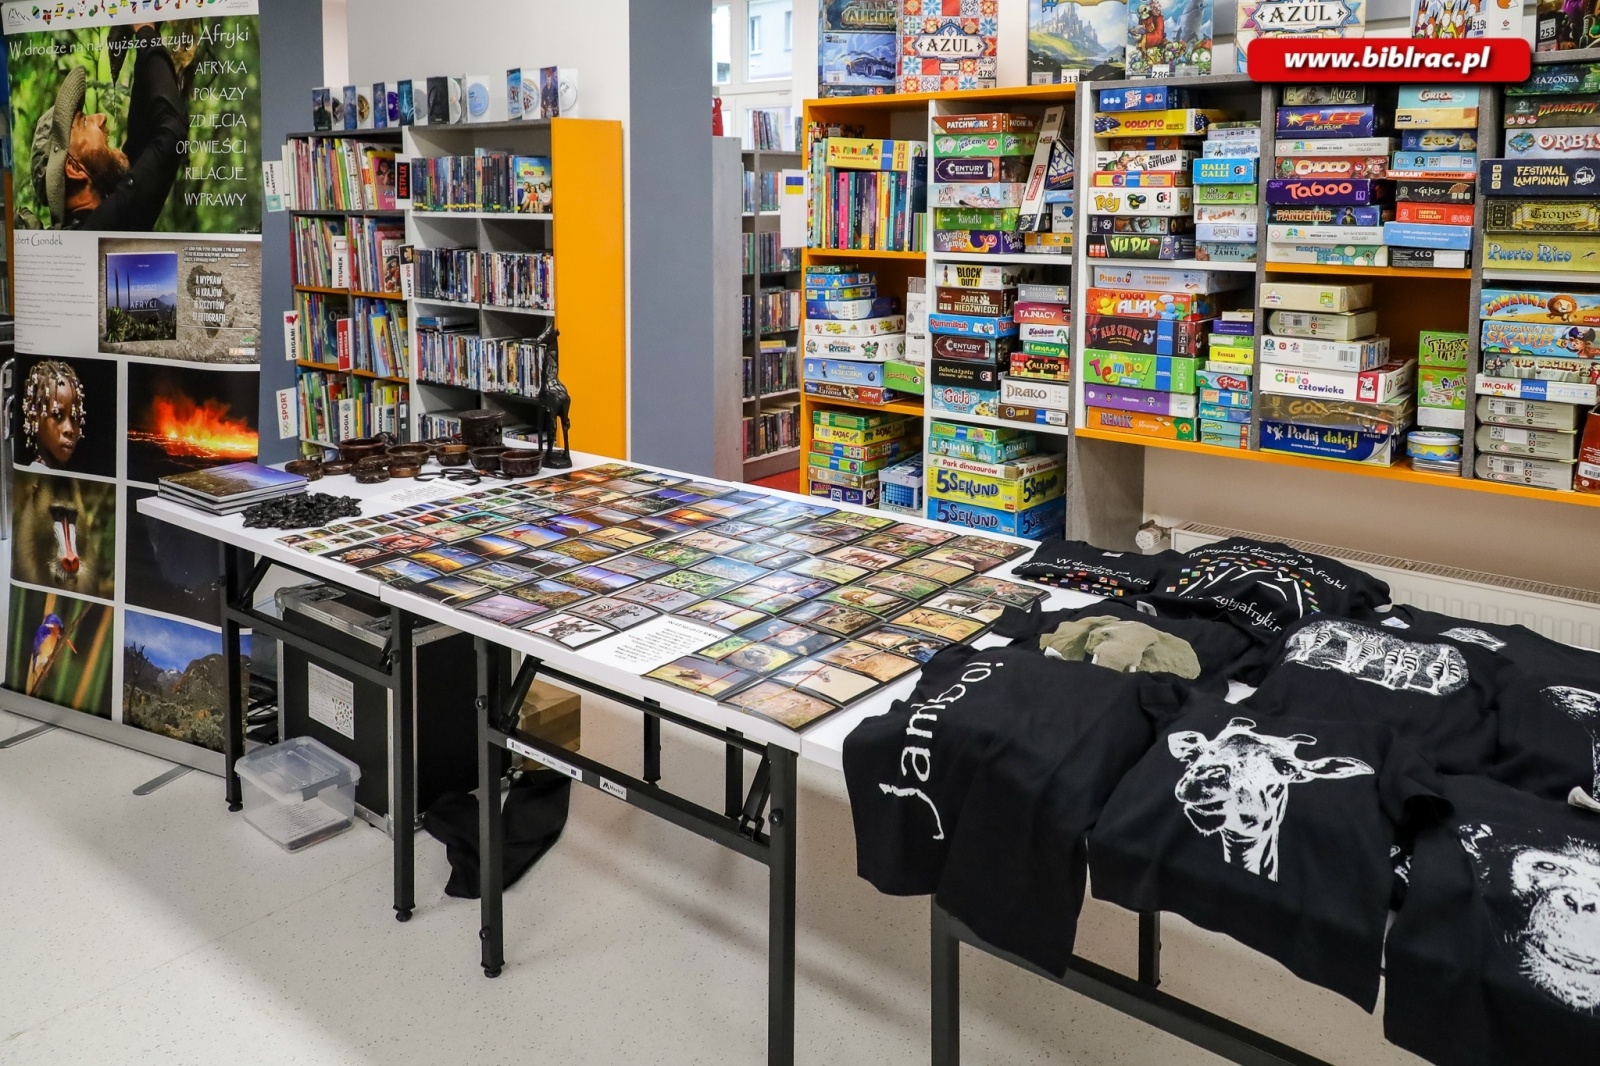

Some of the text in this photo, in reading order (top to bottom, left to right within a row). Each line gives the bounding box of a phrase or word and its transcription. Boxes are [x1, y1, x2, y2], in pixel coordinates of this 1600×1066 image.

[1269, 5, 1332, 23] AZUL
[1540, 27, 1555, 38] 253
[24, 37, 67, 57] drodze
[150, 31, 194, 52] szczyty
[197, 23, 249, 49] Afryki
[926, 38, 974, 53] AZUL
[194, 60, 248, 75] AFRYKA
[978, 69, 992, 77] 478
[1152, 70, 1169, 79] 286
[1063, 75, 1078, 83] 313
[194, 86, 247, 101] POKAZY
[1537, 102, 1598, 117] DIAMENTY
[189, 112, 247, 129] ZDJĘCIA
[946, 120, 989, 129] PATCHWORK
[1124, 118, 1165, 129] COLORIO
[175, 138, 248, 155] OPOWIEŚCI
[947, 163, 984, 174] CENTURY
[1148, 154, 1178, 169] SZPIEGA!
[1201, 163, 1230, 171] HALLI
[1295, 159, 1351, 175] CHOCO
[185, 166, 247, 181] RELACJE
[1201, 170, 1230, 178] GALLI
[1388, 170, 1423, 178] WARCABY
[1516, 165, 1567, 176] FESTIWAL
[399, 165, 408, 196] NETFLIX
[1513, 175, 1570, 188] LAMPIONÓW
[1285, 181, 1353, 200] Taboo
[184, 192, 247, 207] WYPRAWY
[1094, 192, 1121, 213] RÓJ
[957, 214, 982, 225] Kwiatki
[1276, 209, 1332, 222] PANDEMIC
[1530, 207, 1582, 221] Troyes
[31, 232, 63, 247] Gondek
[1110, 236, 1151, 252] VUDU
[1488, 242, 1572, 264] Puerto Rico
[956, 266, 983, 278] BLOCK
[960, 277, 978, 287] OUT!
[960, 295, 979, 304] PARK
[1120, 292, 1146, 300] DICE
[130, 300, 157, 310] AFRYKI
[953, 303, 999, 314] NIEDŹWIEDZI
[1117, 299, 1157, 318] ALIAS
[1484, 292, 1548, 317] SAWANNA
[1018, 309, 1056, 319] TAJNIACY
[930, 319, 968, 330] Rummikub
[1487, 323, 1541, 335] WYPRAWA
[1100, 325, 1116, 339] ALE
[945, 341, 981, 351] CENTURY
[1486, 331, 1556, 348] SKARB
[828, 344, 851, 353] RYCERZ
[1025, 359, 1060, 371] CALLISTO
[1536, 358, 1584, 371] SECRET
[1274, 372, 1309, 385] Ciało
[1005, 384, 1048, 399] DRAKO
[1298, 384, 1345, 395] człowieka
[280, 392, 289, 421] SPORT
[1101, 412, 1133, 429] REMIK
[1287, 424, 1319, 446] Podaj
[1323, 430, 1359, 450] dalej!
[940, 439, 975, 454] ŚLIMAKI
[942, 459, 998, 475] Park dinozaurów
[936, 469, 999, 498] 5 SEKUND
[936, 500, 998, 528] 5 SEKUND
[1117, 573, 1151, 585] Afry
[1299, 567, 1348, 591] Afryki
